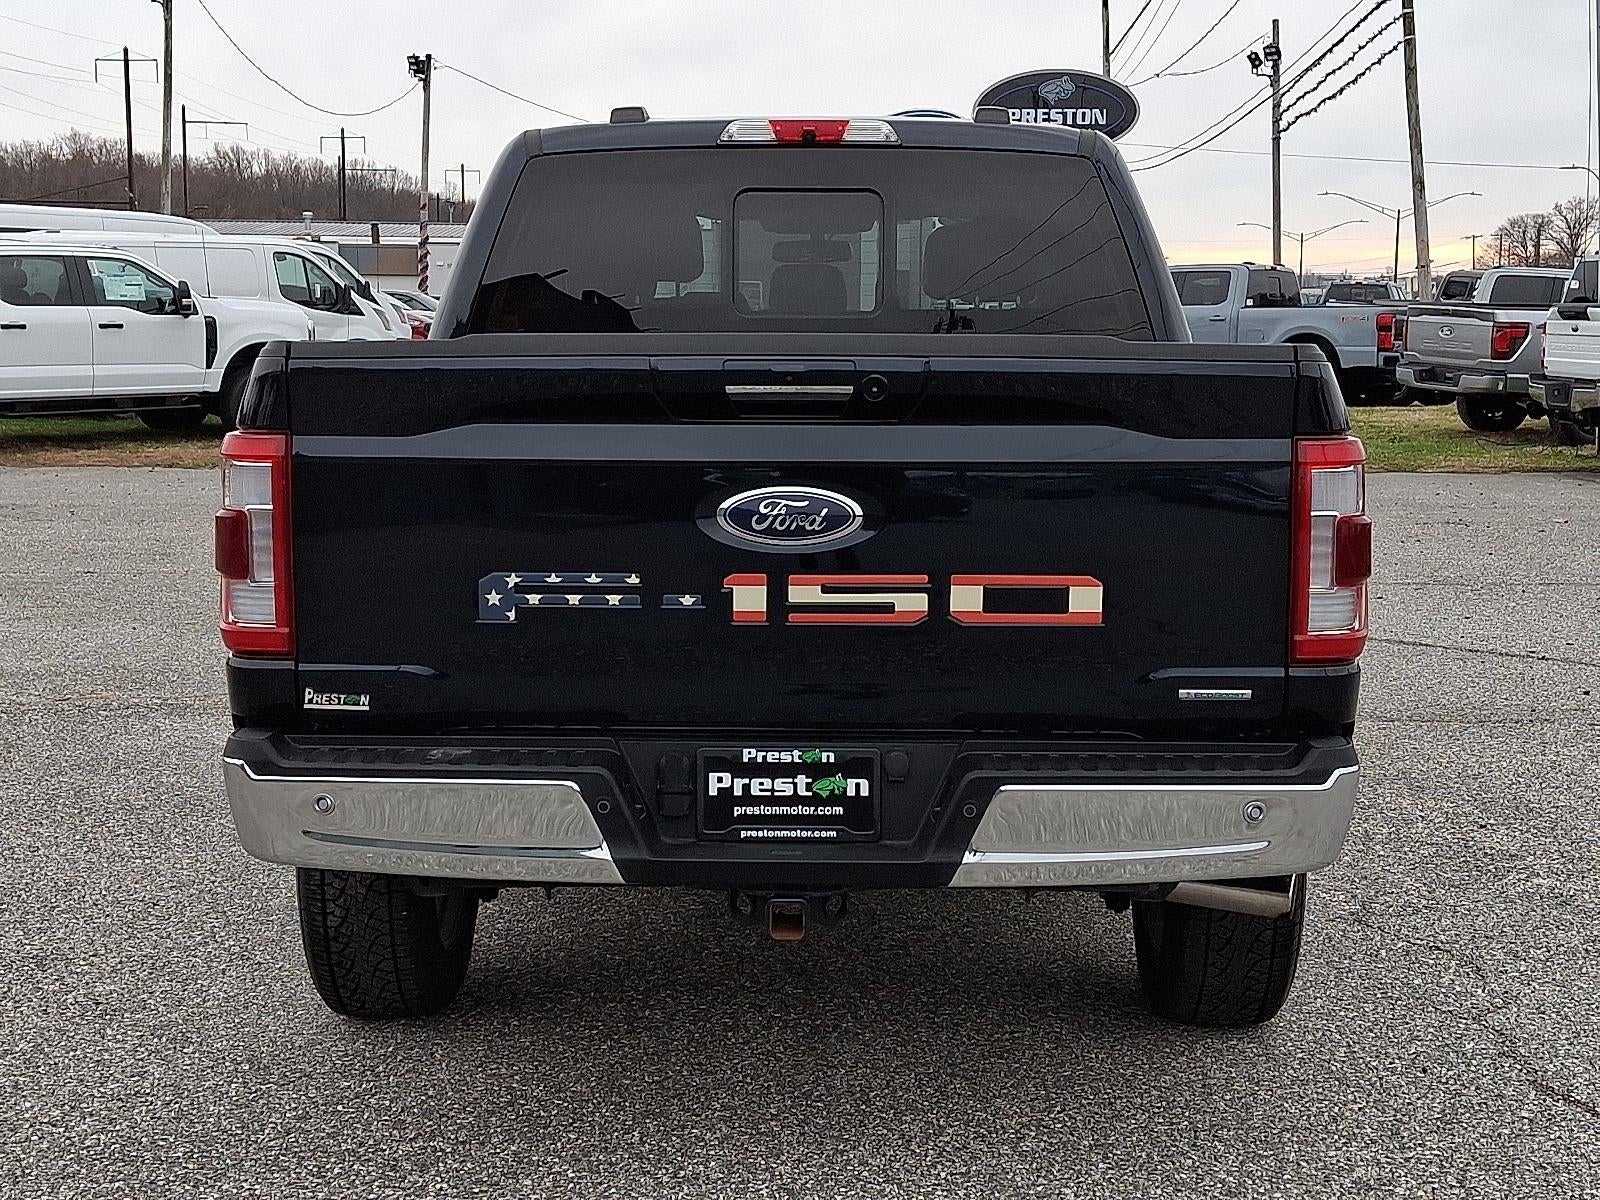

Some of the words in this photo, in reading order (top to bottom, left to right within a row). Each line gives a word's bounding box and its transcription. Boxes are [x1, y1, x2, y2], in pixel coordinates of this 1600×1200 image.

[1008, 108, 1107, 125] PRESTON
[751, 498, 829, 531] Ford
[477, 571, 1104, 625] F-150
[733, 804, 844, 818] prestonmotor.com
[740, 829, 837, 839] prestonmotor.com
